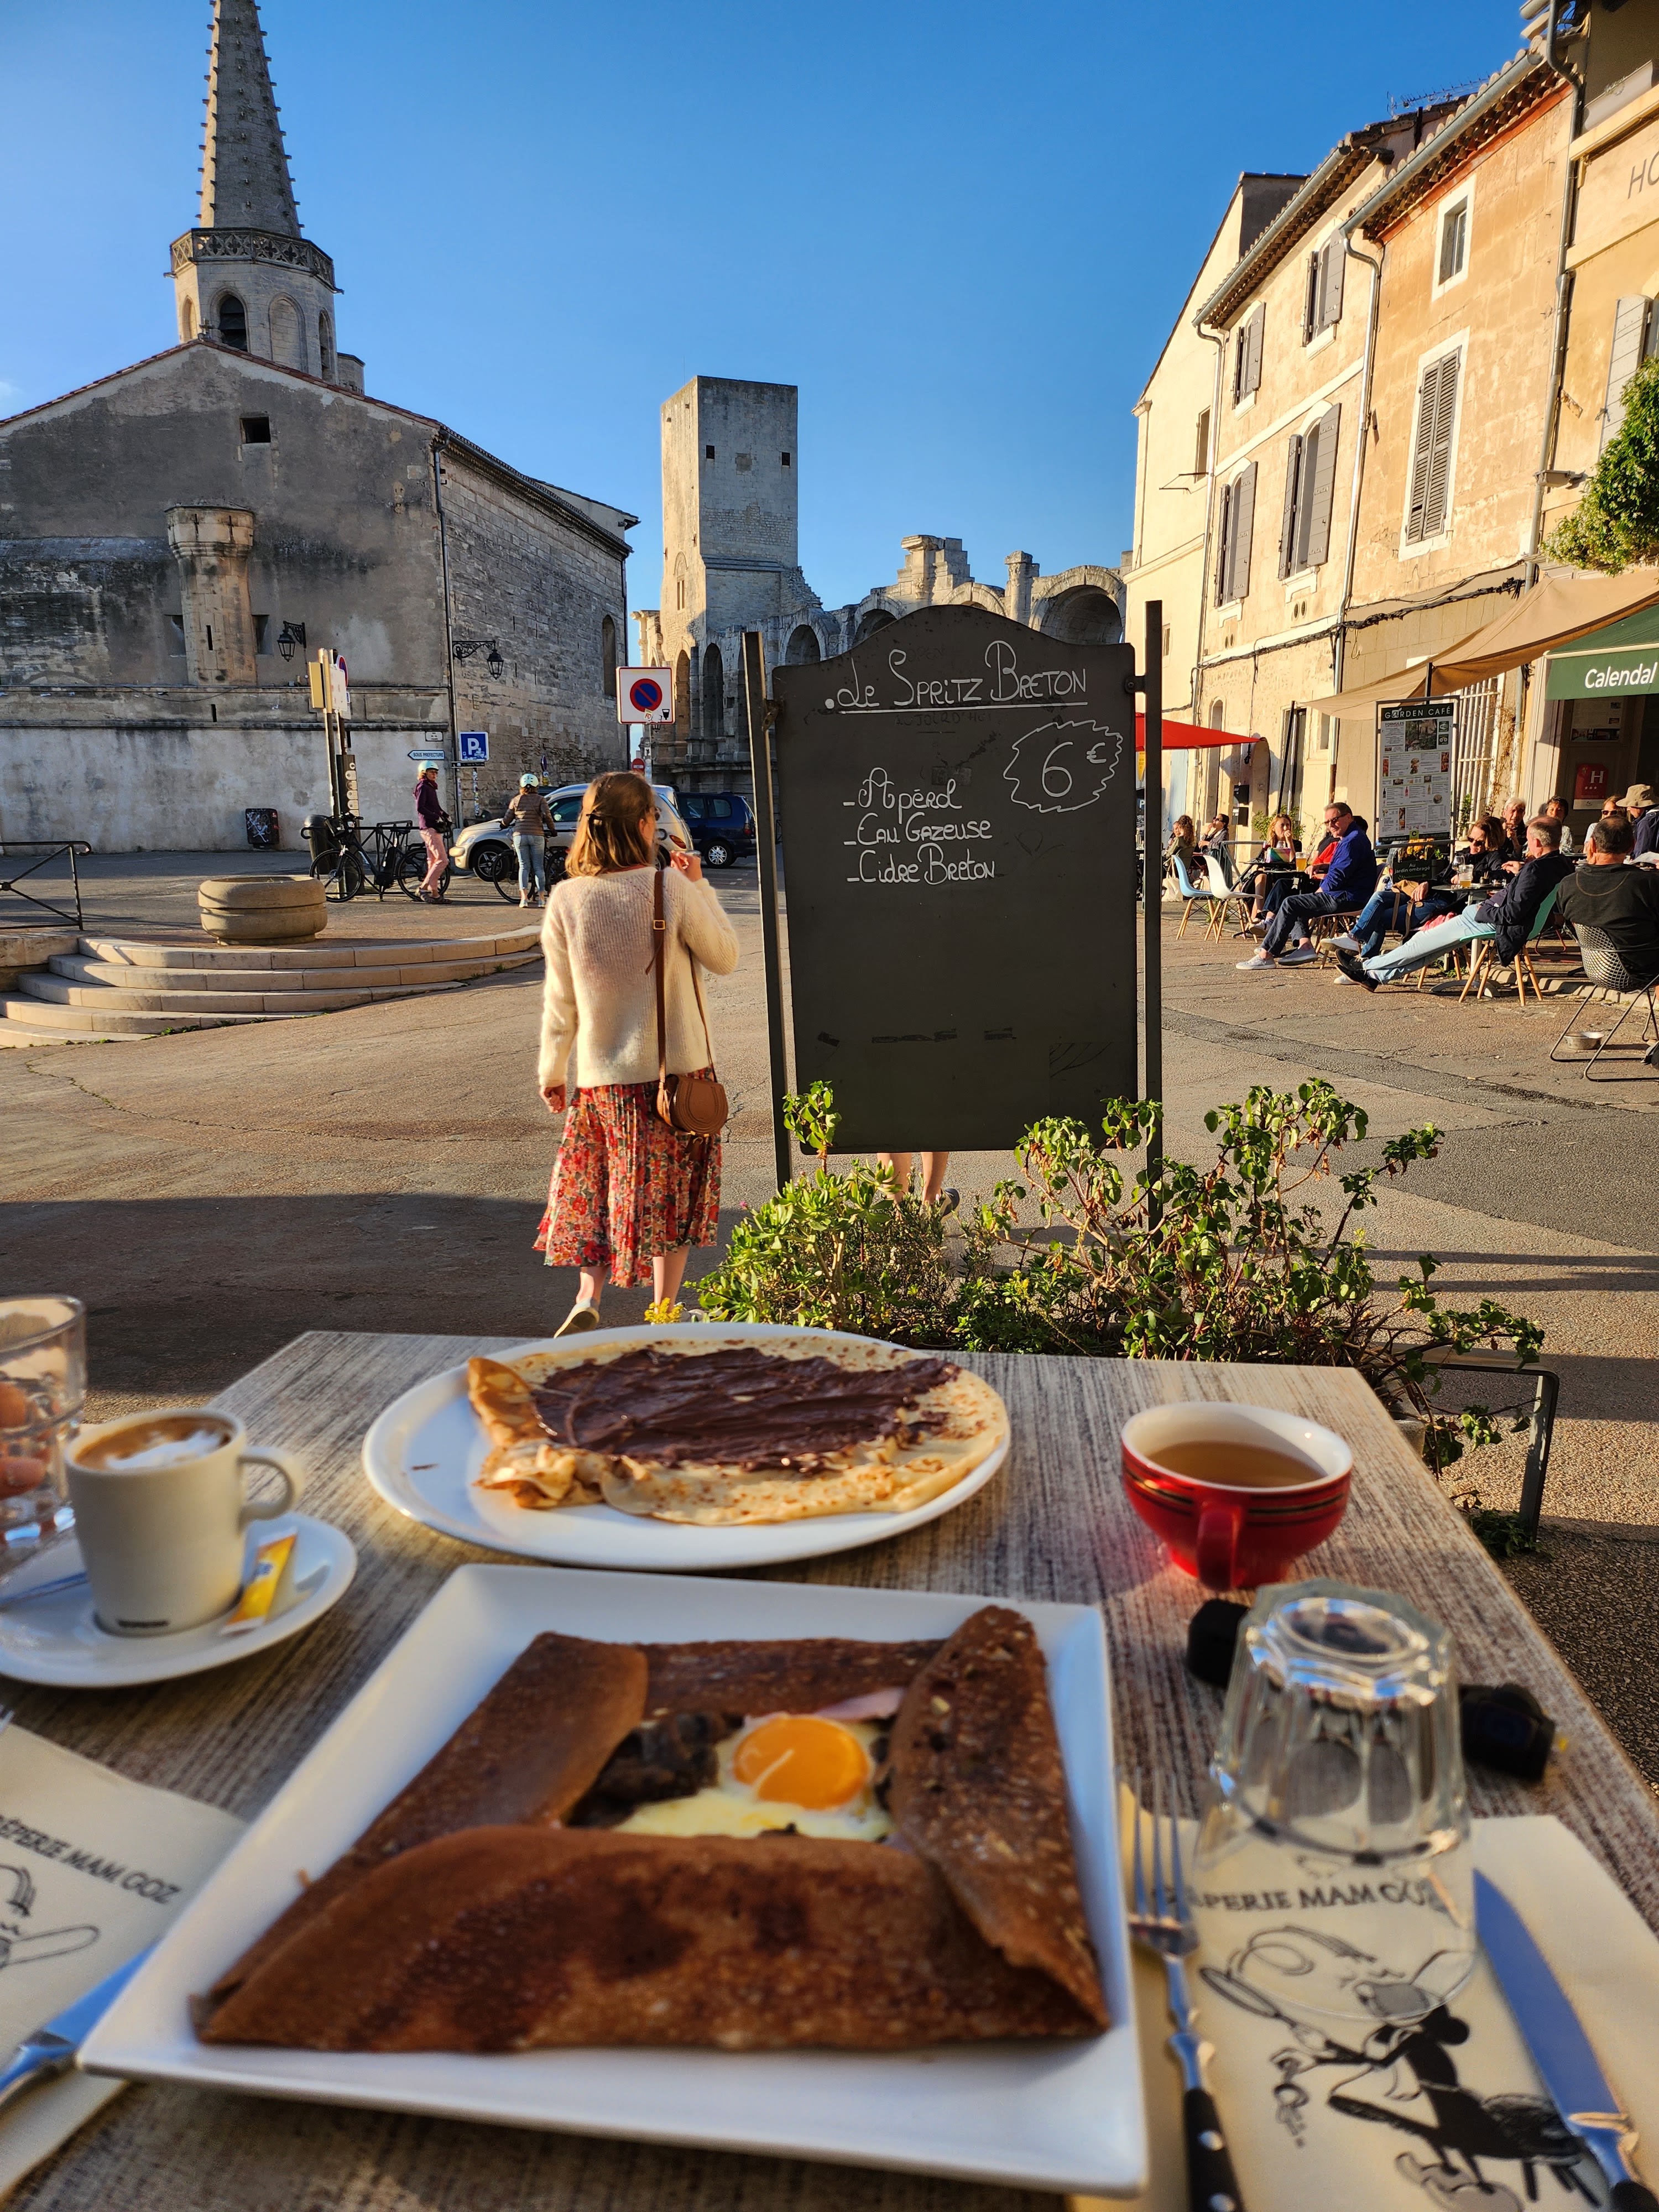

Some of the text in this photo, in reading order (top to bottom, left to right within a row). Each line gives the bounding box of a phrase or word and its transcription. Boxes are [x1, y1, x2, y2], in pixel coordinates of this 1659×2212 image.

[1584, 662, 1658, 689] Calendal
[1428, 706, 1451, 716] CAFÉ
[467, 738, 479, 755] P
[1590, 770, 1604, 784] H
[1297, 1883, 1377, 1909] MAM
